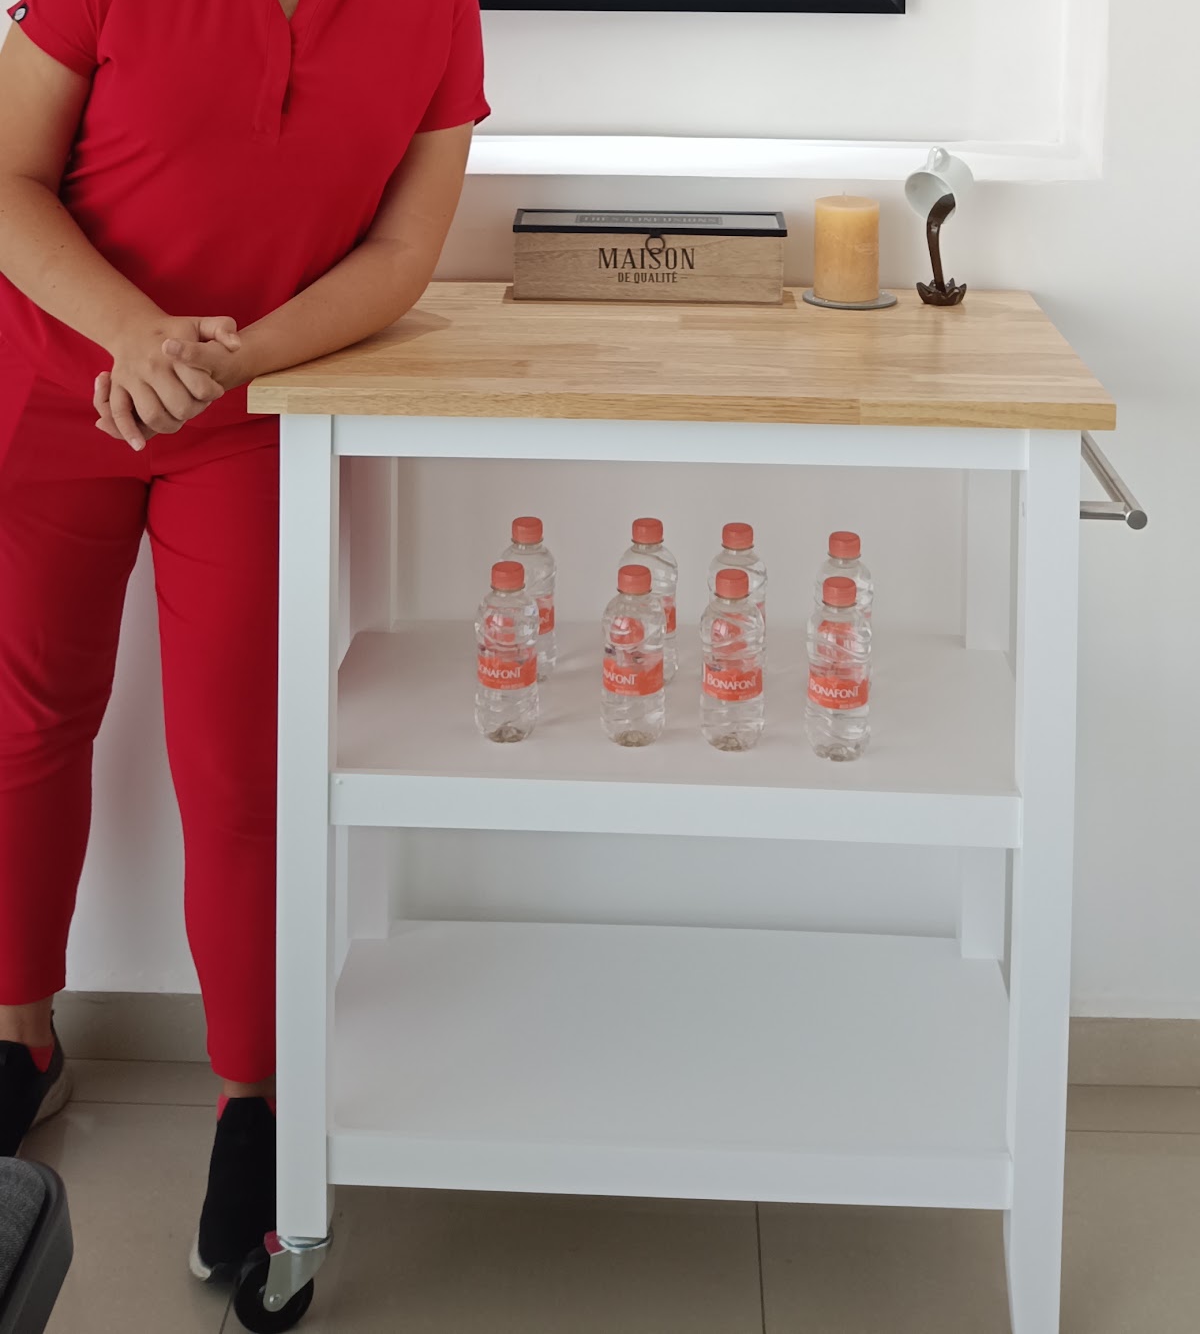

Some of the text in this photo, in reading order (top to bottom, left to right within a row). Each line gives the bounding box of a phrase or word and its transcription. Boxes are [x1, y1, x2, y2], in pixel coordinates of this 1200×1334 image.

[598, 247, 695, 270] MAISON
[618, 271, 678, 284] DE QUALITÉ
[707, 673, 756, 690] BONAFONT
[810, 678, 860, 698] BONAFONT
